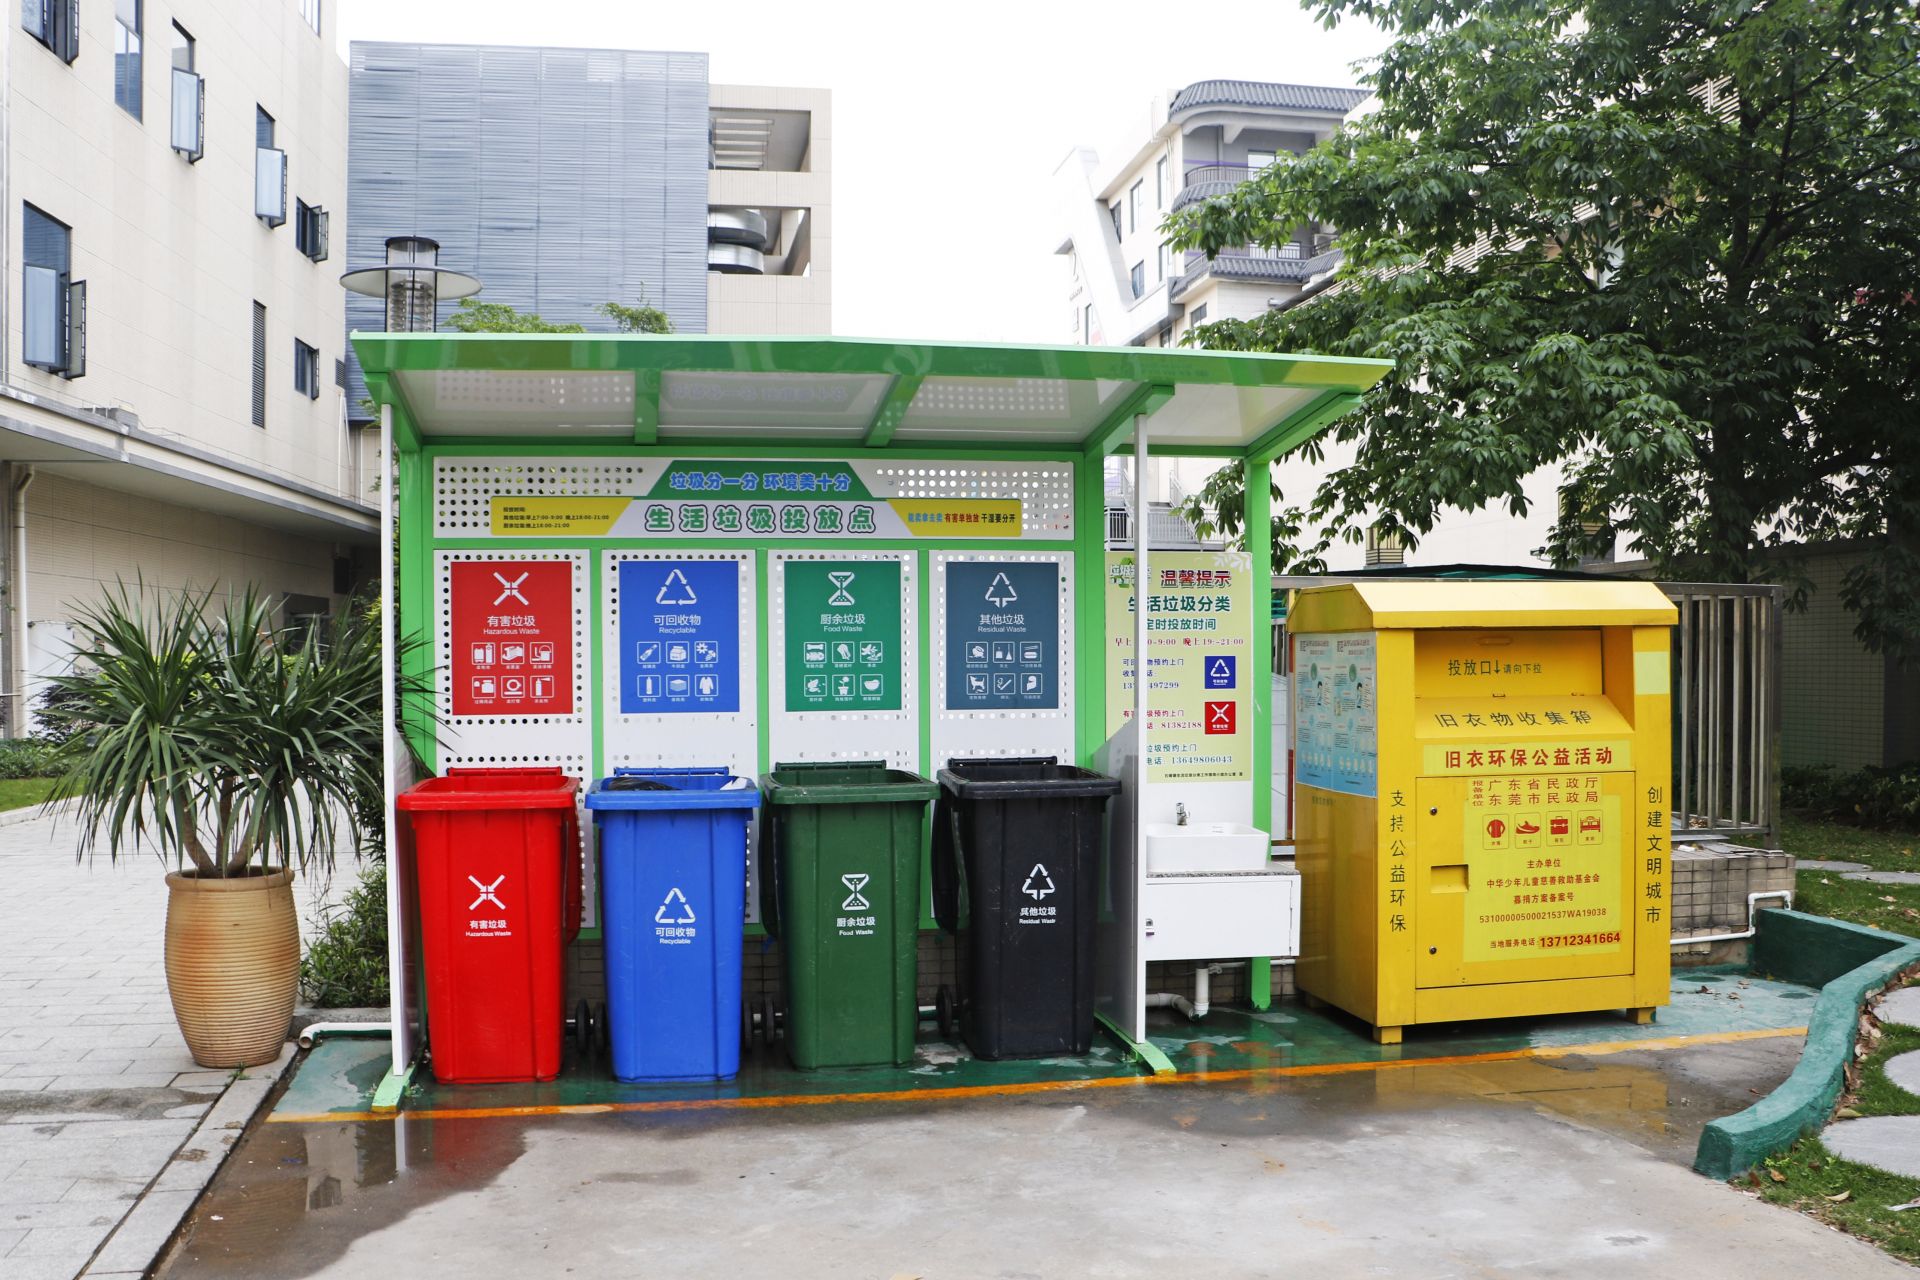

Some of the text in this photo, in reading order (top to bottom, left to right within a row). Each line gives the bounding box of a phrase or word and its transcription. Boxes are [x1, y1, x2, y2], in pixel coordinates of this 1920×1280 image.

[670, 472, 852, 491] 垃圾分一分 环境美十分
[646, 505, 875, 532] 生活垃圾投放点
[944, 513, 979, 523] 有害单独放
[1161, 570, 1231, 588] 温馨提示
[487, 616, 536, 626] 有害垃圾
[653, 614, 701, 626] 可回收物
[820, 614, 866, 624] 厨余垃圾
[980, 614, 1024, 625] 其他垃圾
[1448, 659, 1542, 676] 投放口 请向下拉
[1435, 710, 1592, 728] 旧衣物收集箱
[1446, 747, 1612, 769] 旧衣环保公益活动
[1488, 777, 1598, 791] 广东省民政厅
[1472, 780, 1483, 806] 报备单位
[1488, 792, 1598, 806] 东莞市民政局
[1390, 790, 1406, 933] 支持公益环保
[1646, 787, 1663, 924] 创建文明城市
[1527, 859, 1561, 869] 主办单位
[1487, 874, 1600, 888] 中华少年儿童慈善救助基金会
[1514, 892, 1574, 905] 募捐方案备案号
[1020, 907, 1056, 916] 其他垃圾
[470, 920, 507, 929] 有害垃圾
[836, 916, 875, 927] 厨余垃圾
[655, 928, 696, 937] 可回收物
[1539, 932, 1620, 948] 13712341664
